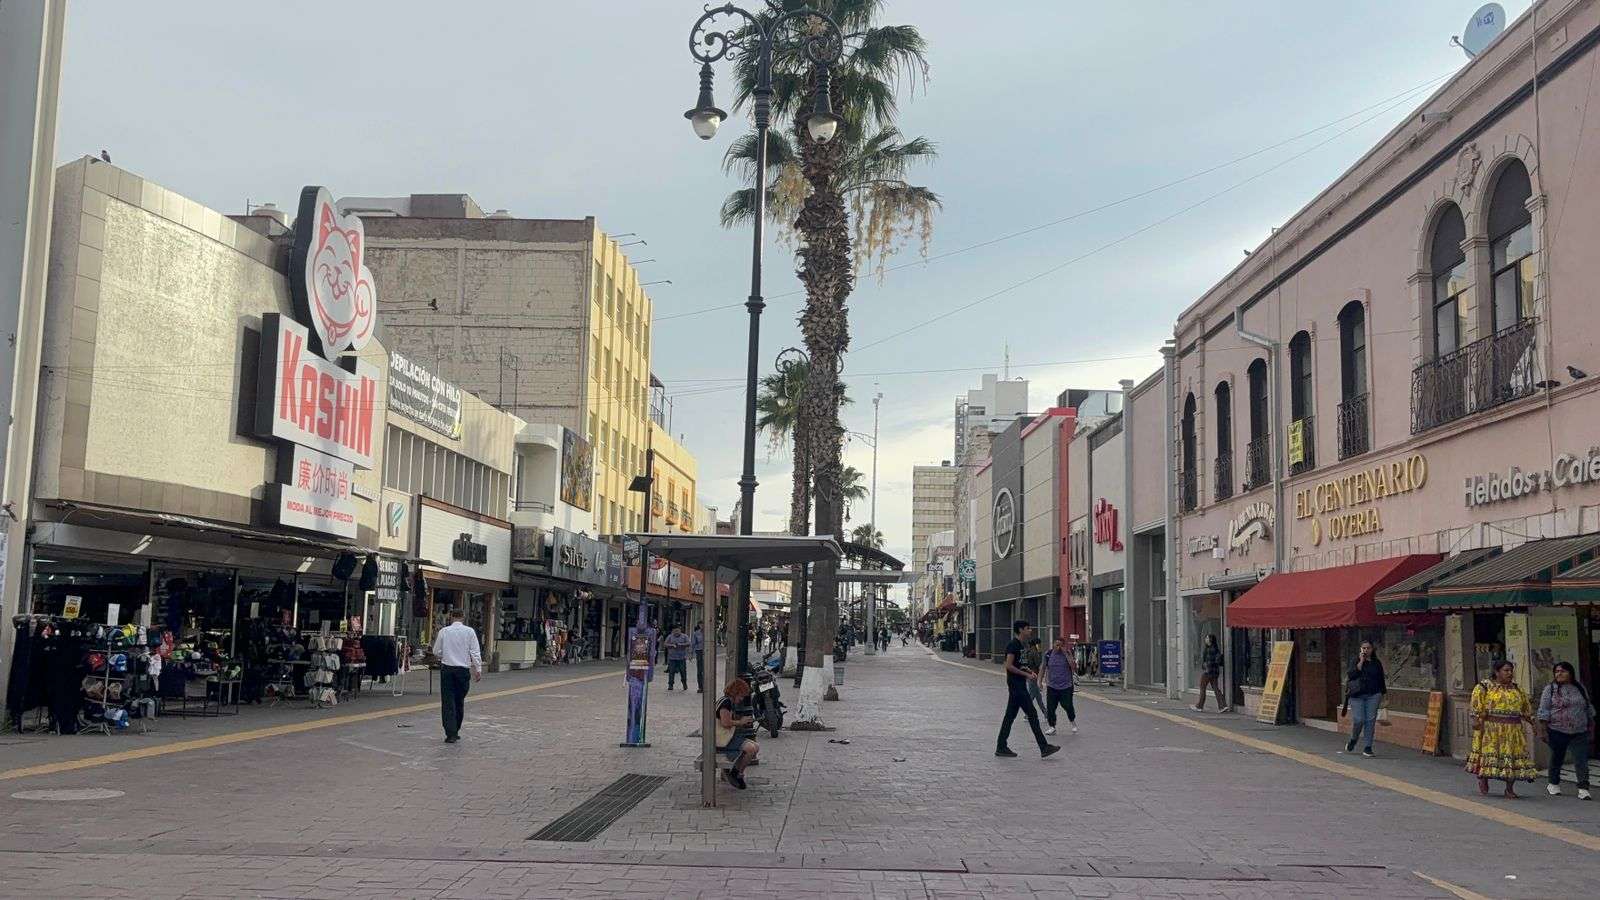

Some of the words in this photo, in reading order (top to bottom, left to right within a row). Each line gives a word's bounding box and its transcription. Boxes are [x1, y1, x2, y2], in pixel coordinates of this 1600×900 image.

[279, 328, 375, 457] KASHIN
[431, 375, 446, 397] CON
[1296, 489, 1313, 519] EL
[1314, 453, 1428, 513] CENTENARIO
[1464, 465, 1537, 507] Helados
[286, 500, 304, 512] MODA
[313, 506, 333, 519] MEJOR
[333, 511, 354, 523] PRECIO
[1328, 507, 1383, 542] JOYERIA
